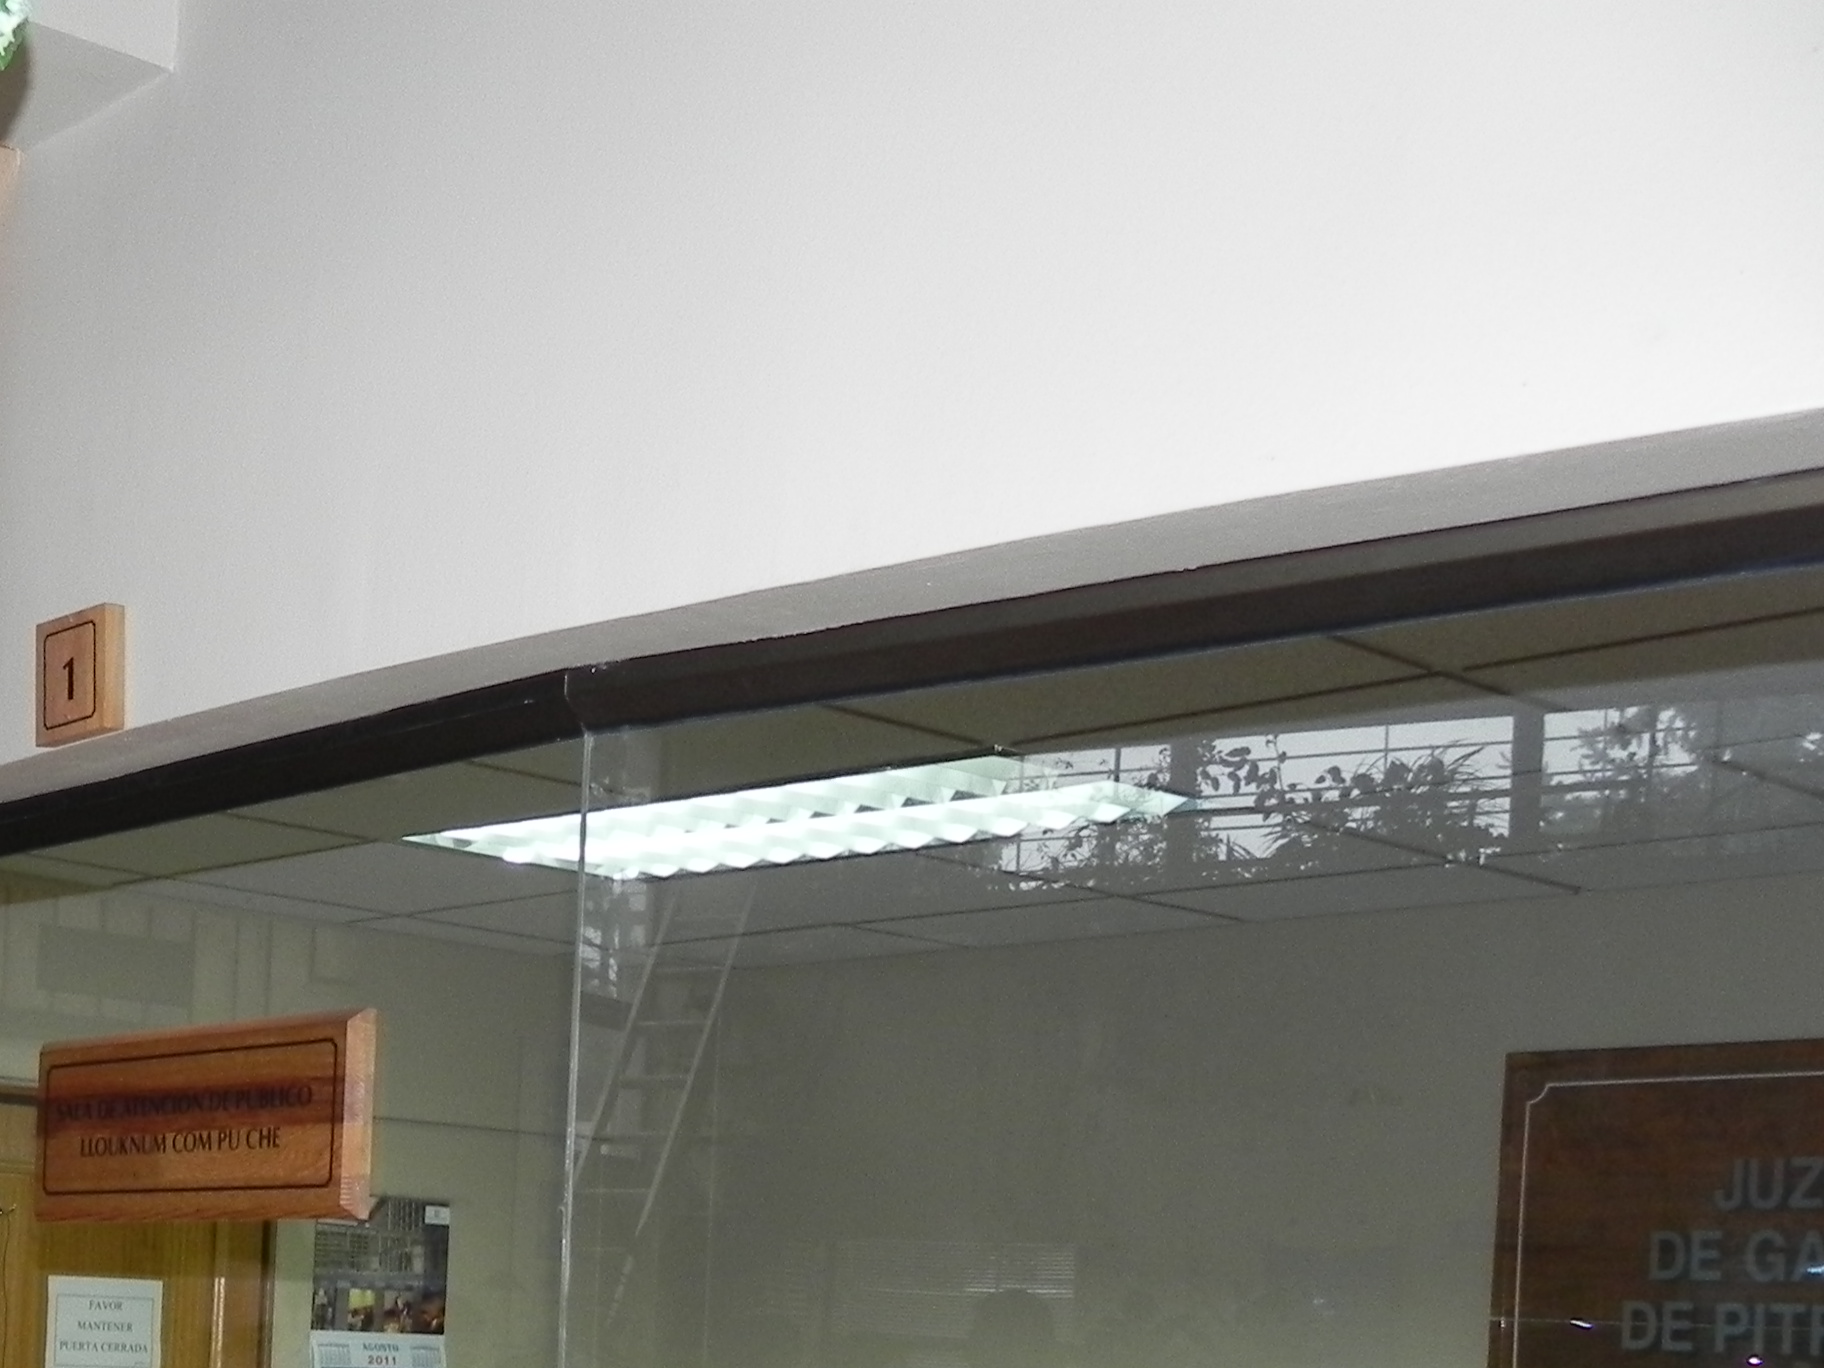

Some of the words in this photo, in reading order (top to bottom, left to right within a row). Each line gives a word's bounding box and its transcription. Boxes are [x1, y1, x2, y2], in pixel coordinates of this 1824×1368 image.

[62, 656, 75, 701] 1
[172, 1130, 213, 1154] COM
[217, 1128, 241, 1150] PU
[245, 1126, 281, 1150] CHE
[1713, 1156, 1824, 1212] JUZ
[1648, 1229, 1723, 1281] DE
[1744, 1229, 1824, 1283] GA
[88, 1299, 124, 1311] FAVOR
[77, 1320, 133, 1333] MANTENER
[1621, 1300, 1694, 1352] DE
[59, 1340, 98, 1353] PUERTA
[100, 1342, 149, 1354] CERRADA
[367, 1355, 397, 1366] 2011
